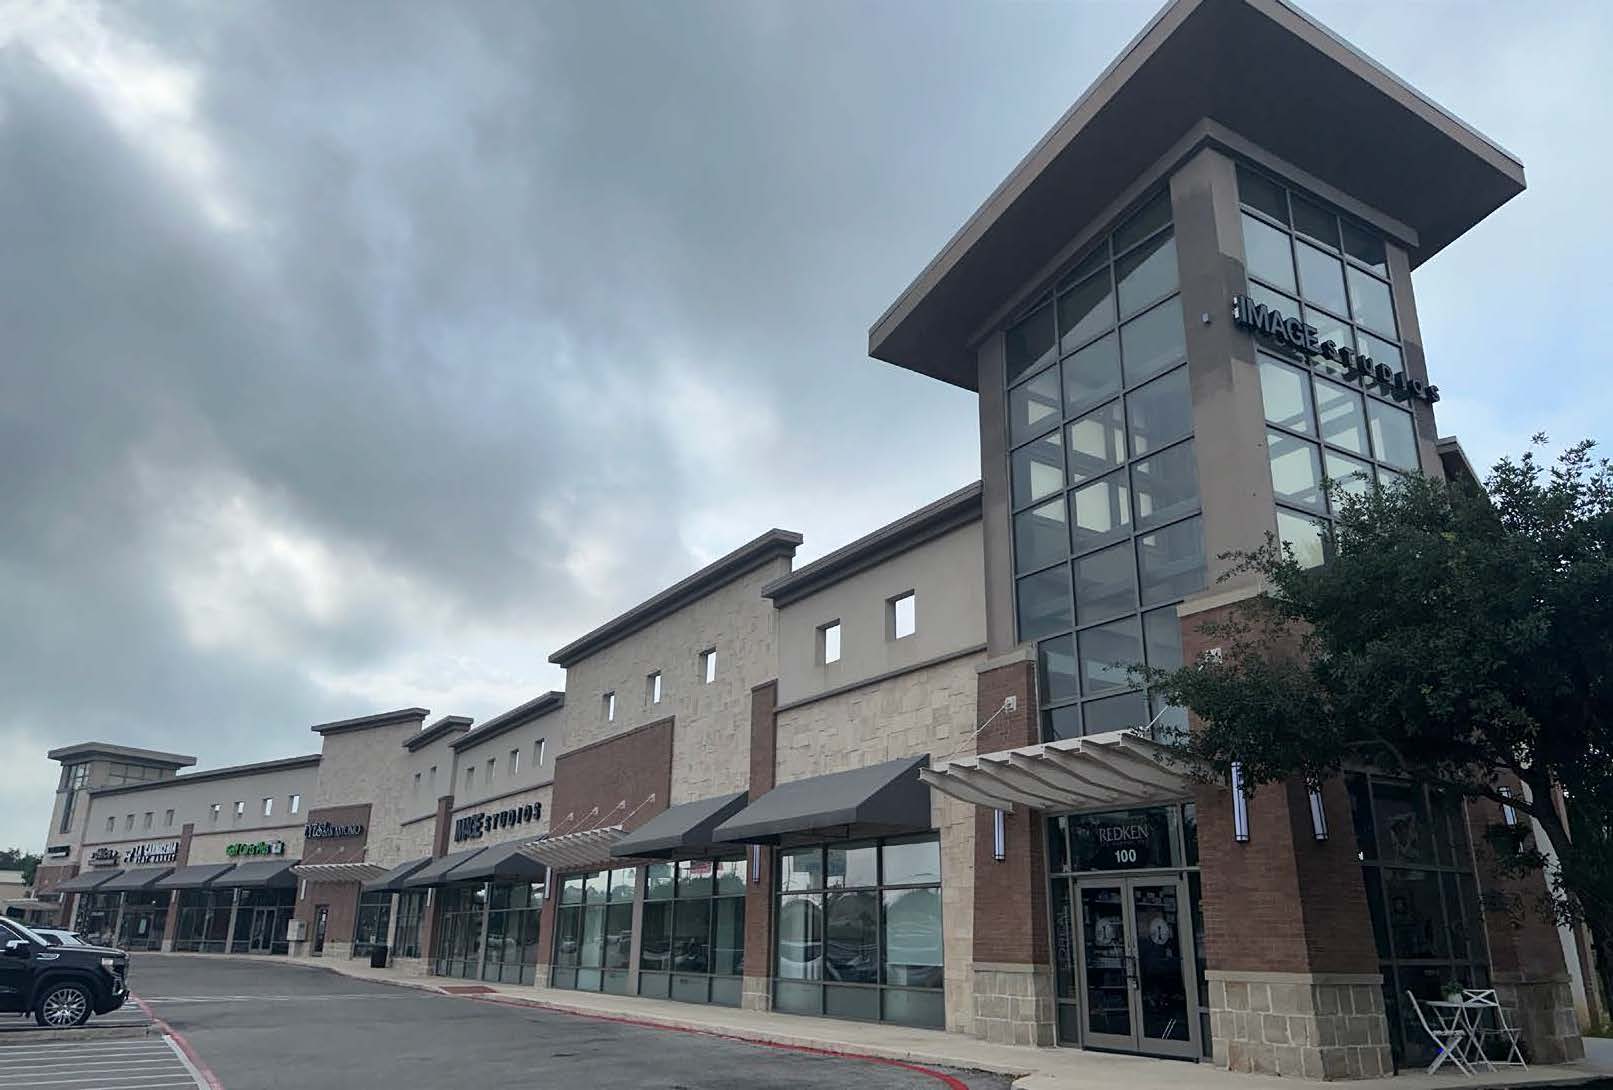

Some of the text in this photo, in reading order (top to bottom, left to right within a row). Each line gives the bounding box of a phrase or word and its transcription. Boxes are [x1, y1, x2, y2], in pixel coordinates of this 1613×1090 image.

[1233, 294, 1441, 403] IMAGE STUDIOS
[484, 802, 542, 832] STUDIOS
[1099, 824, 1149, 842] REDKEN
[1115, 849, 1137, 863] 100
